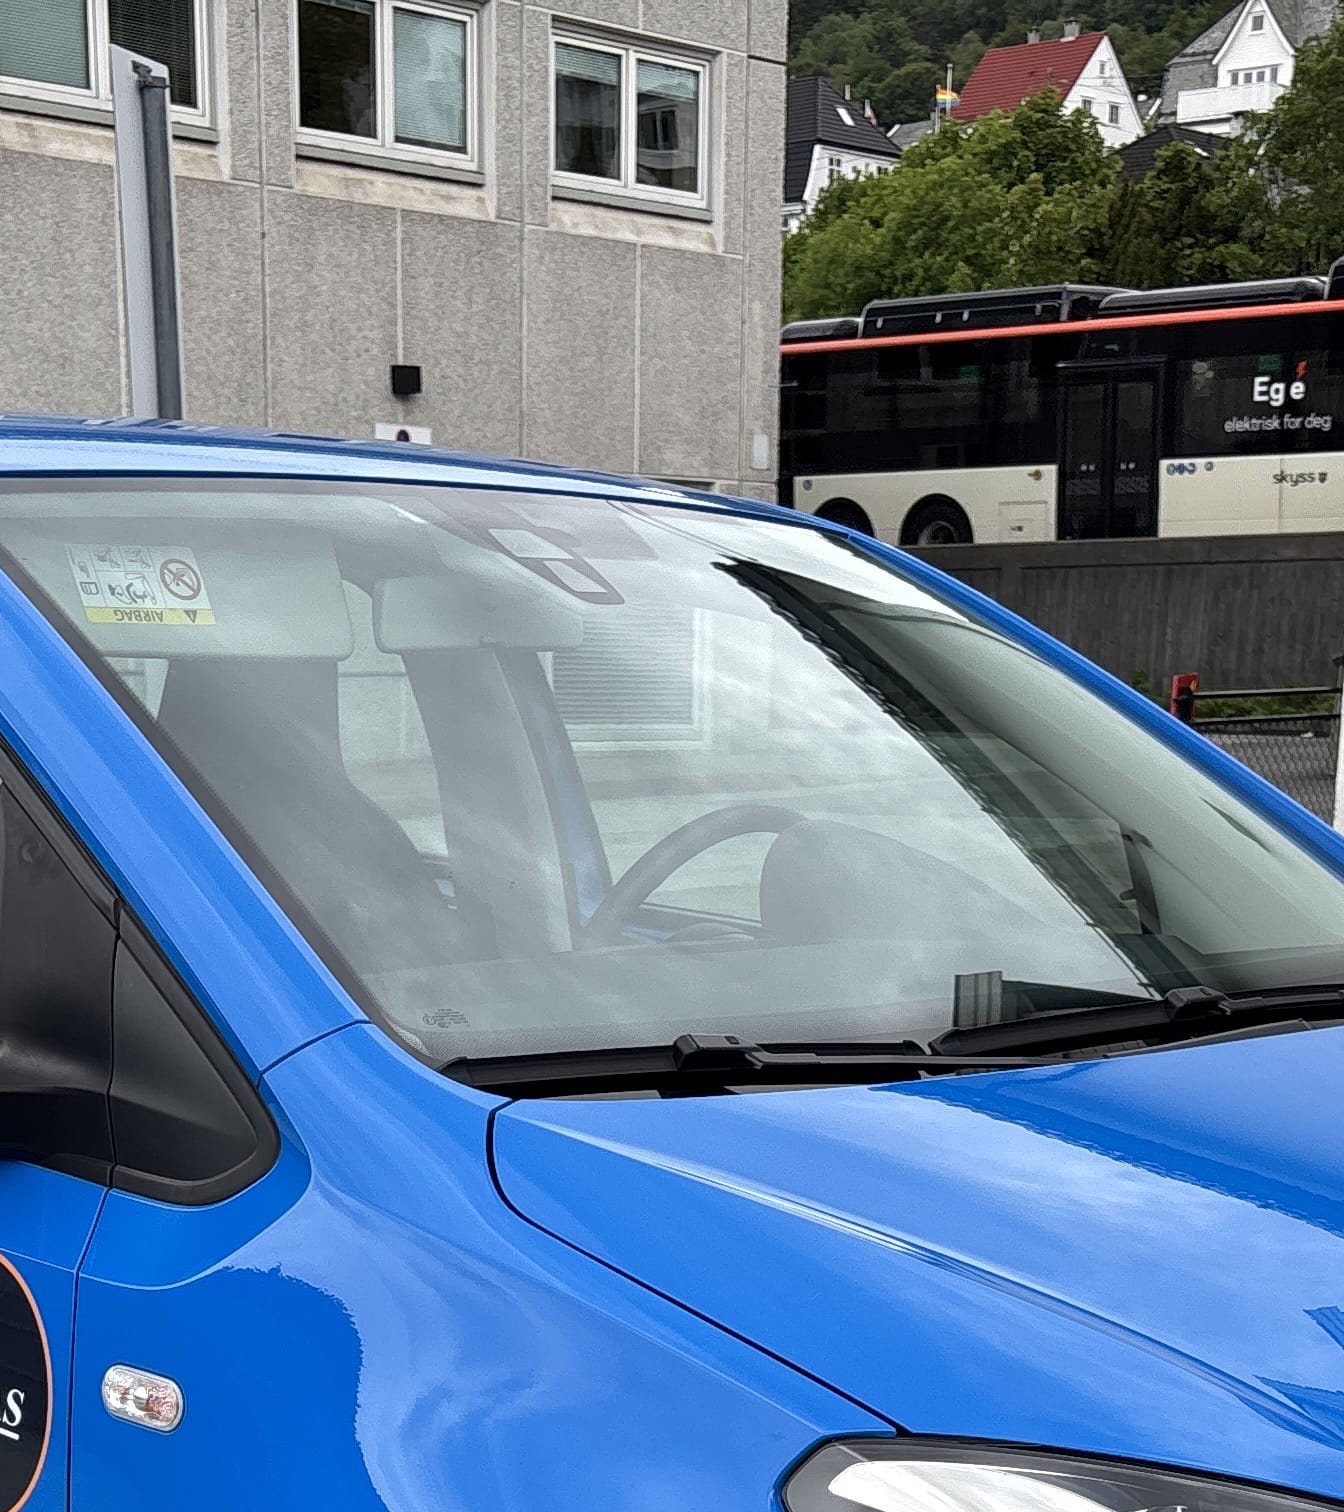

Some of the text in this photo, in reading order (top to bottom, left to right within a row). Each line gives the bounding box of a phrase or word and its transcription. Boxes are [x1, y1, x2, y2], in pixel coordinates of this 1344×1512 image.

[1253, 376, 1286, 407] Eg
[1224, 412, 1332, 433] elektrisk for deg
[1272, 469, 1315, 487] skyss
[113, 609, 164, 623] AIRBAG
